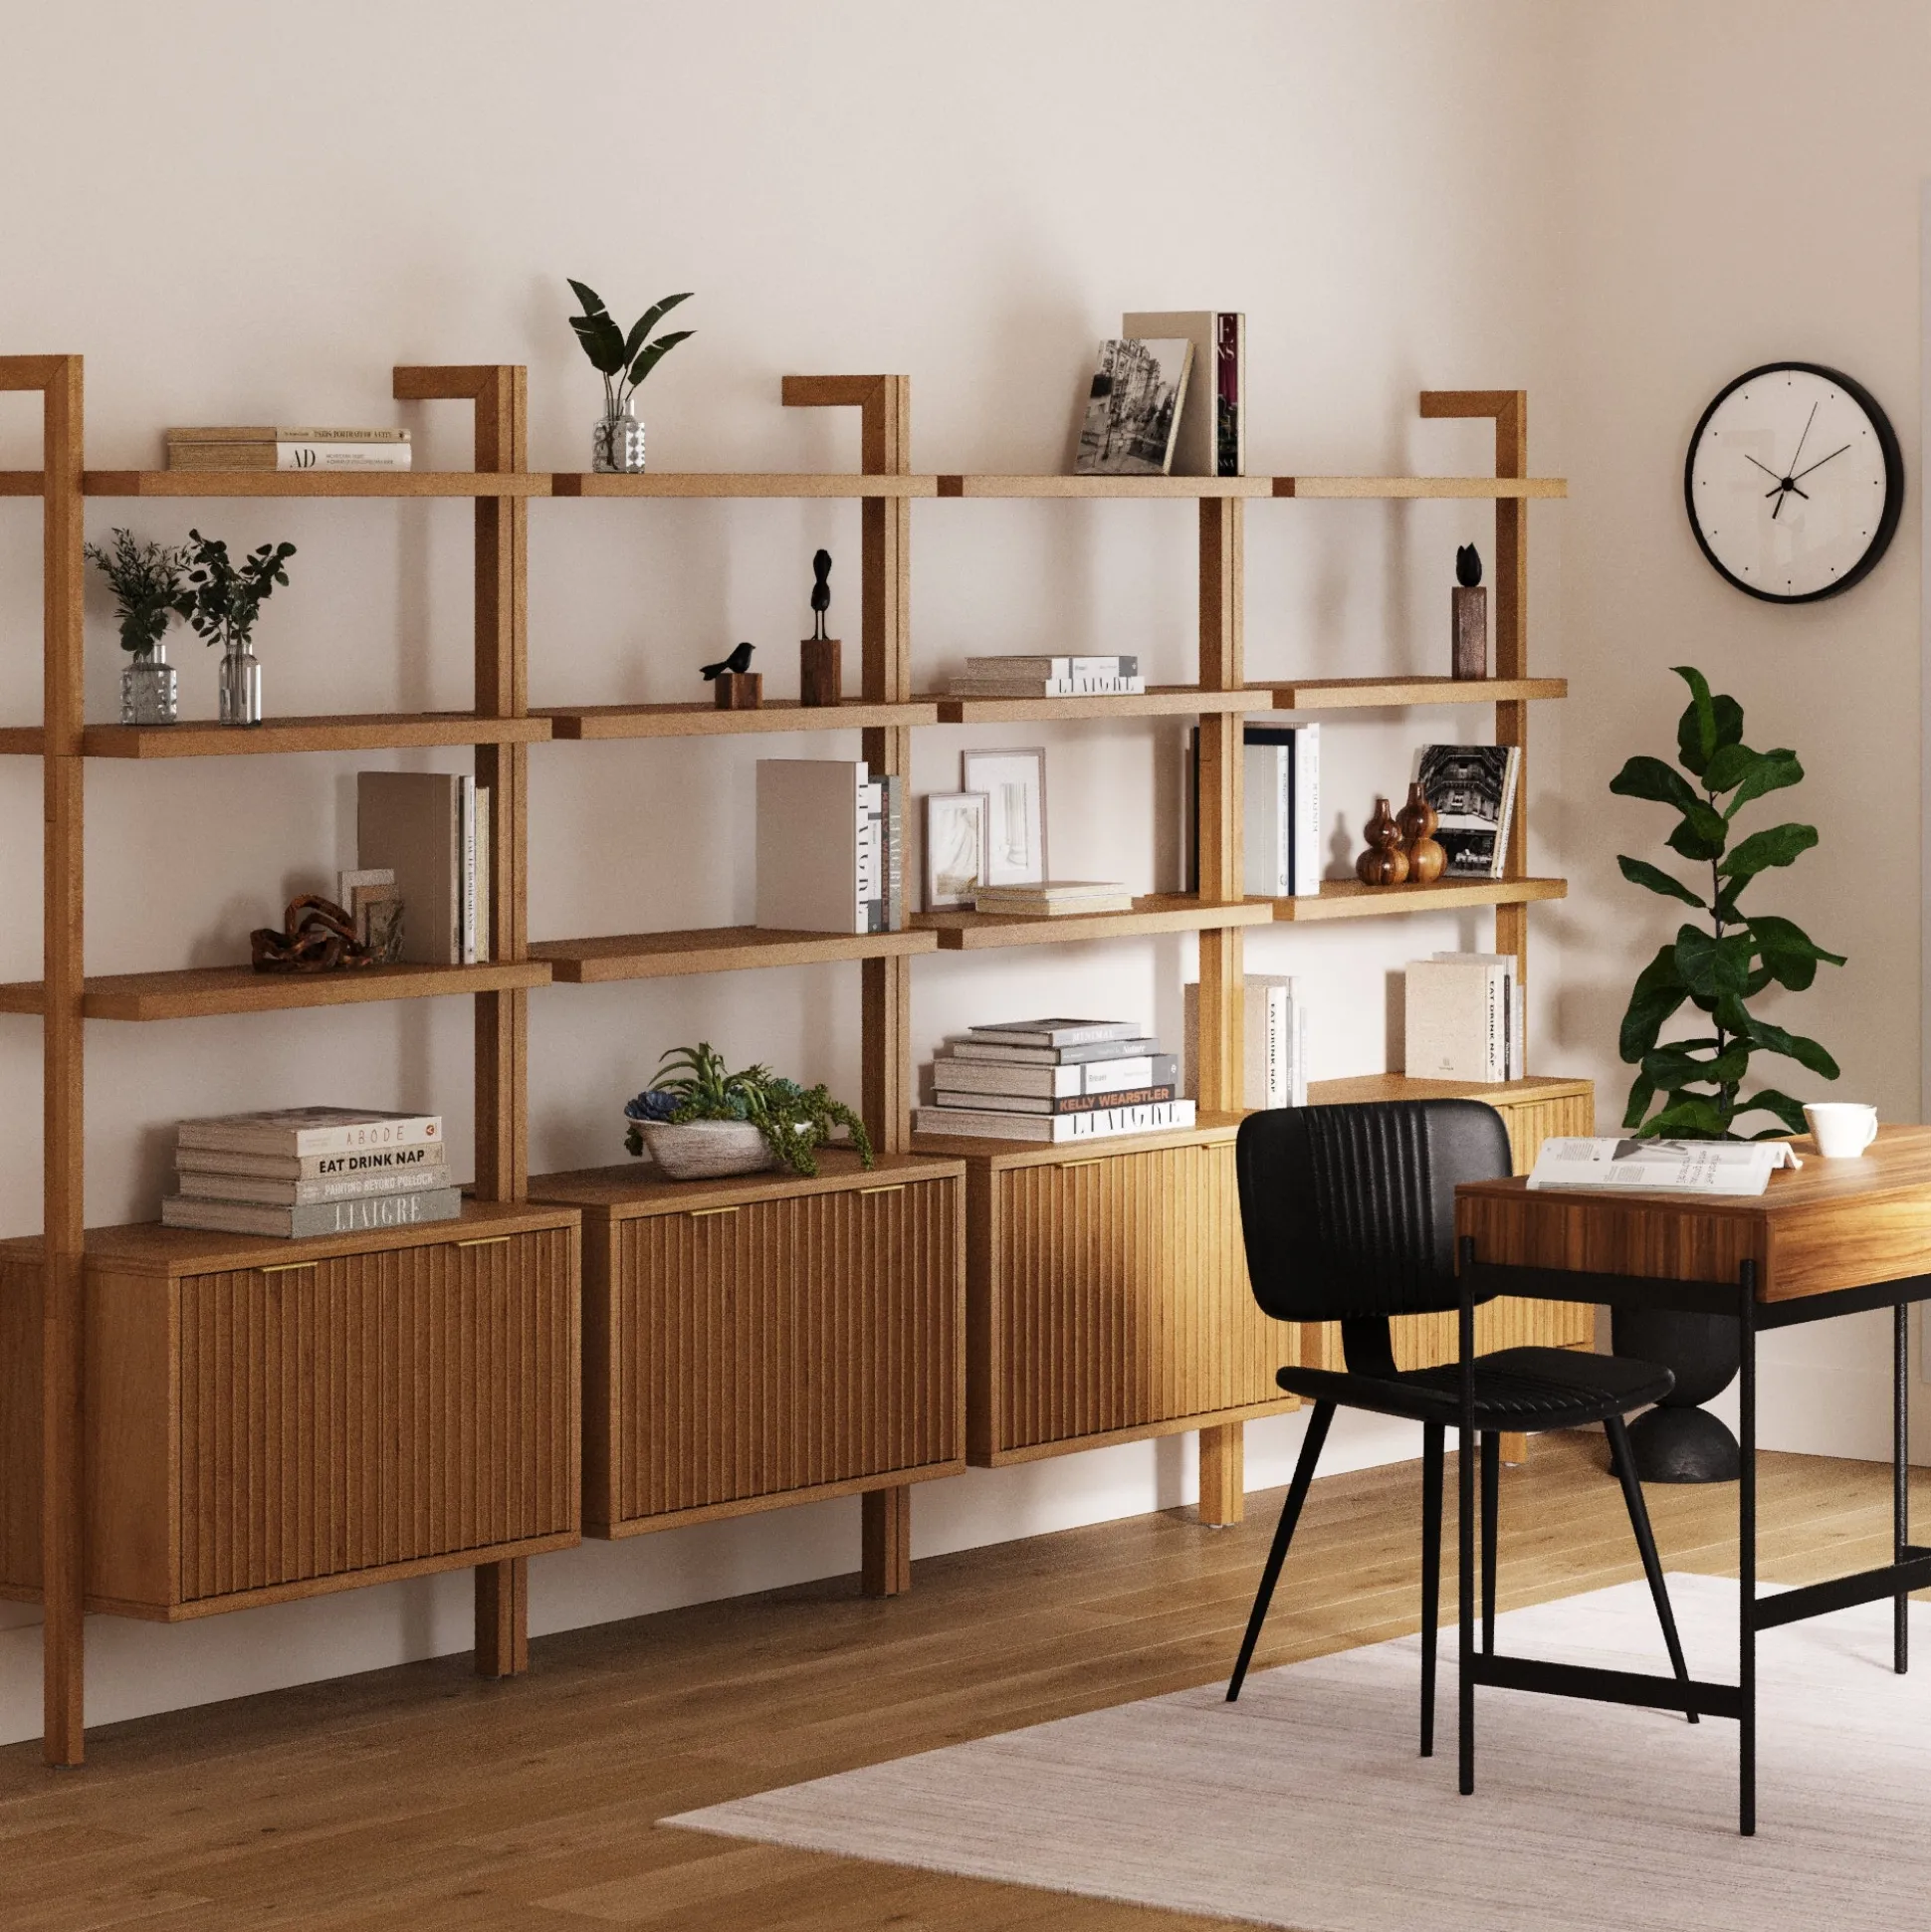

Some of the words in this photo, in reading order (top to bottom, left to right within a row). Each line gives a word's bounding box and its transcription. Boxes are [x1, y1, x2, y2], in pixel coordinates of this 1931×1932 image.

[290, 449, 317, 468] AD
[1059, 1096, 1096, 1112] KELLY
[1098, 1088, 1170, 1107] WEARSTLER
[346, 1125, 405, 1146] ABODE
[320, 1159, 345, 1174] EAT
[348, 1153, 392, 1171] DRINK
[396, 1149, 425, 1166] NAP
[324, 1181, 362, 1195] PAINTING
[363, 1177, 396, 1192] BEYOND
[397, 1173, 434, 1188] POLLOCK
